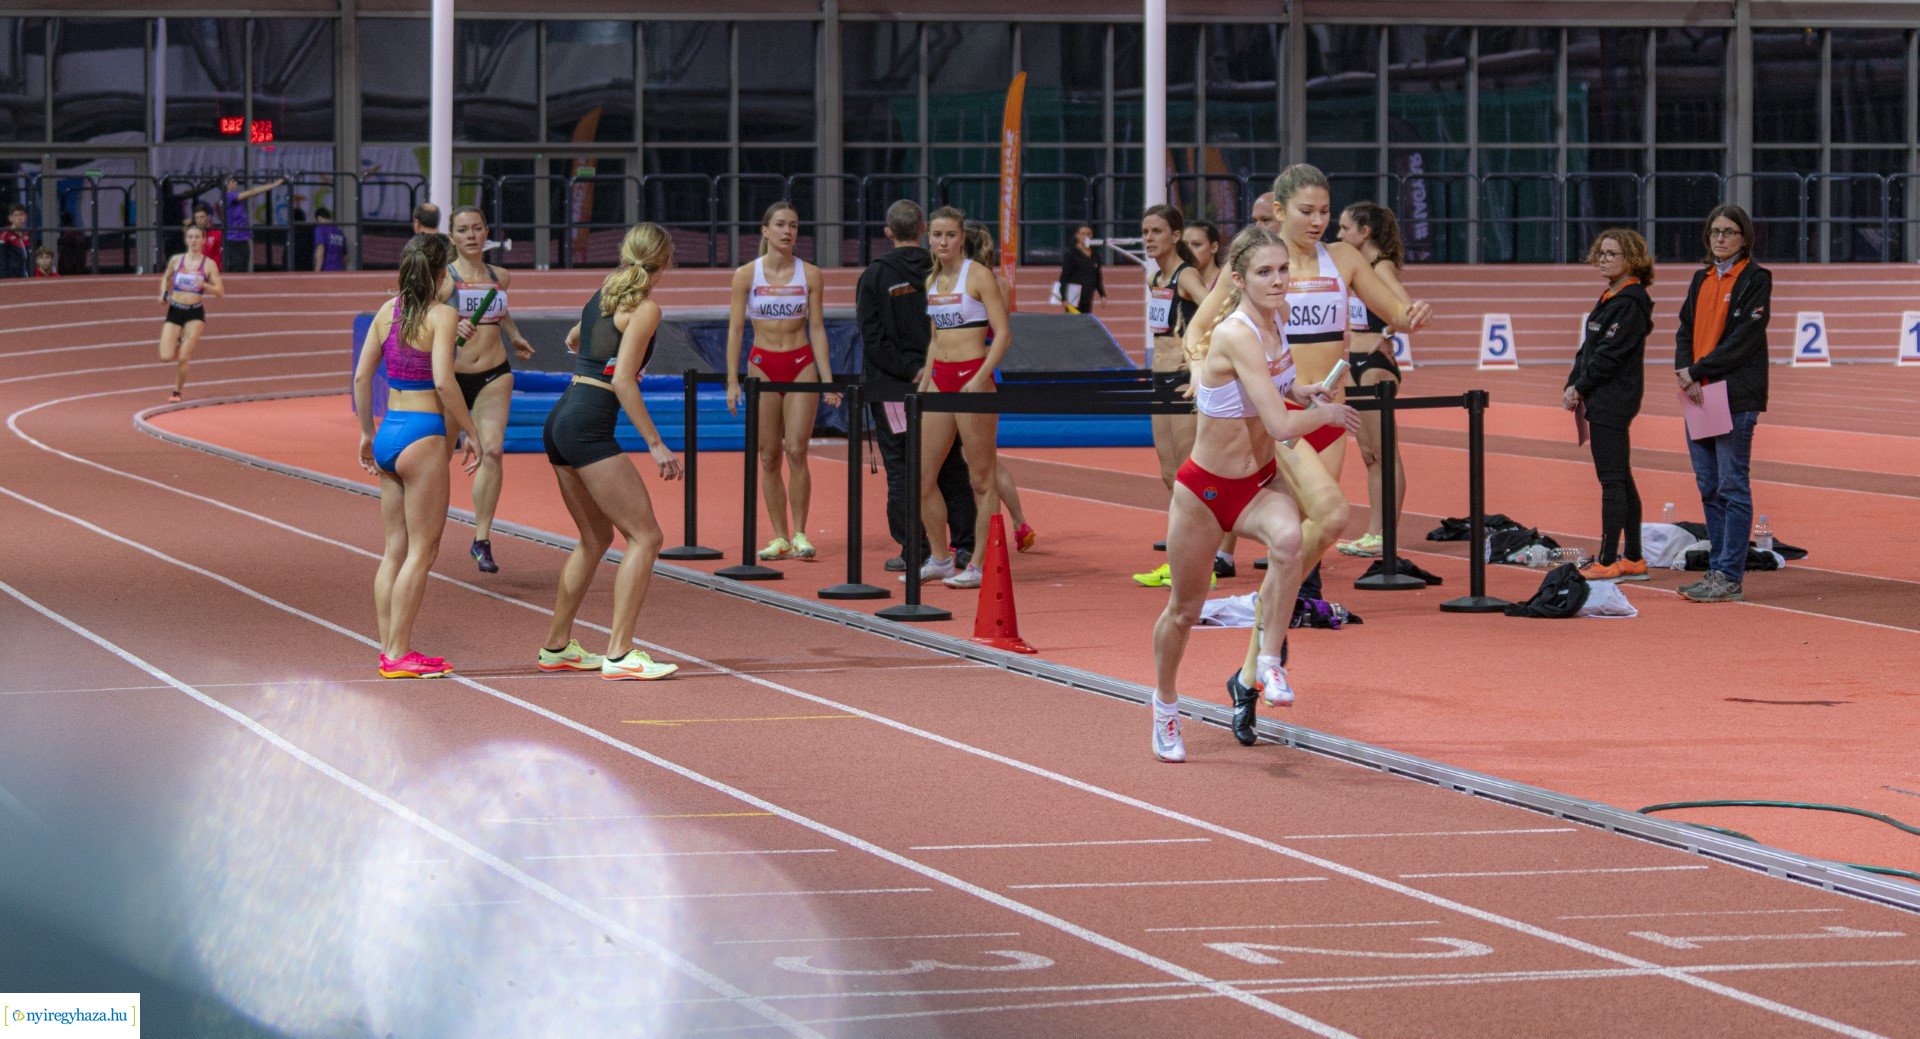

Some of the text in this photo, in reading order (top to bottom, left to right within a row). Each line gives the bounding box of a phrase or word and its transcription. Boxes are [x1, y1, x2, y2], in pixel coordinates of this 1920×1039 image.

[759, 303, 804, 317] VASAS/4
[1288, 304, 1337, 327] SAS/1
[1488, 324, 1509, 356] 5
[1802, 322, 1822, 354] 2
[774, 950, 1055, 976] 3
